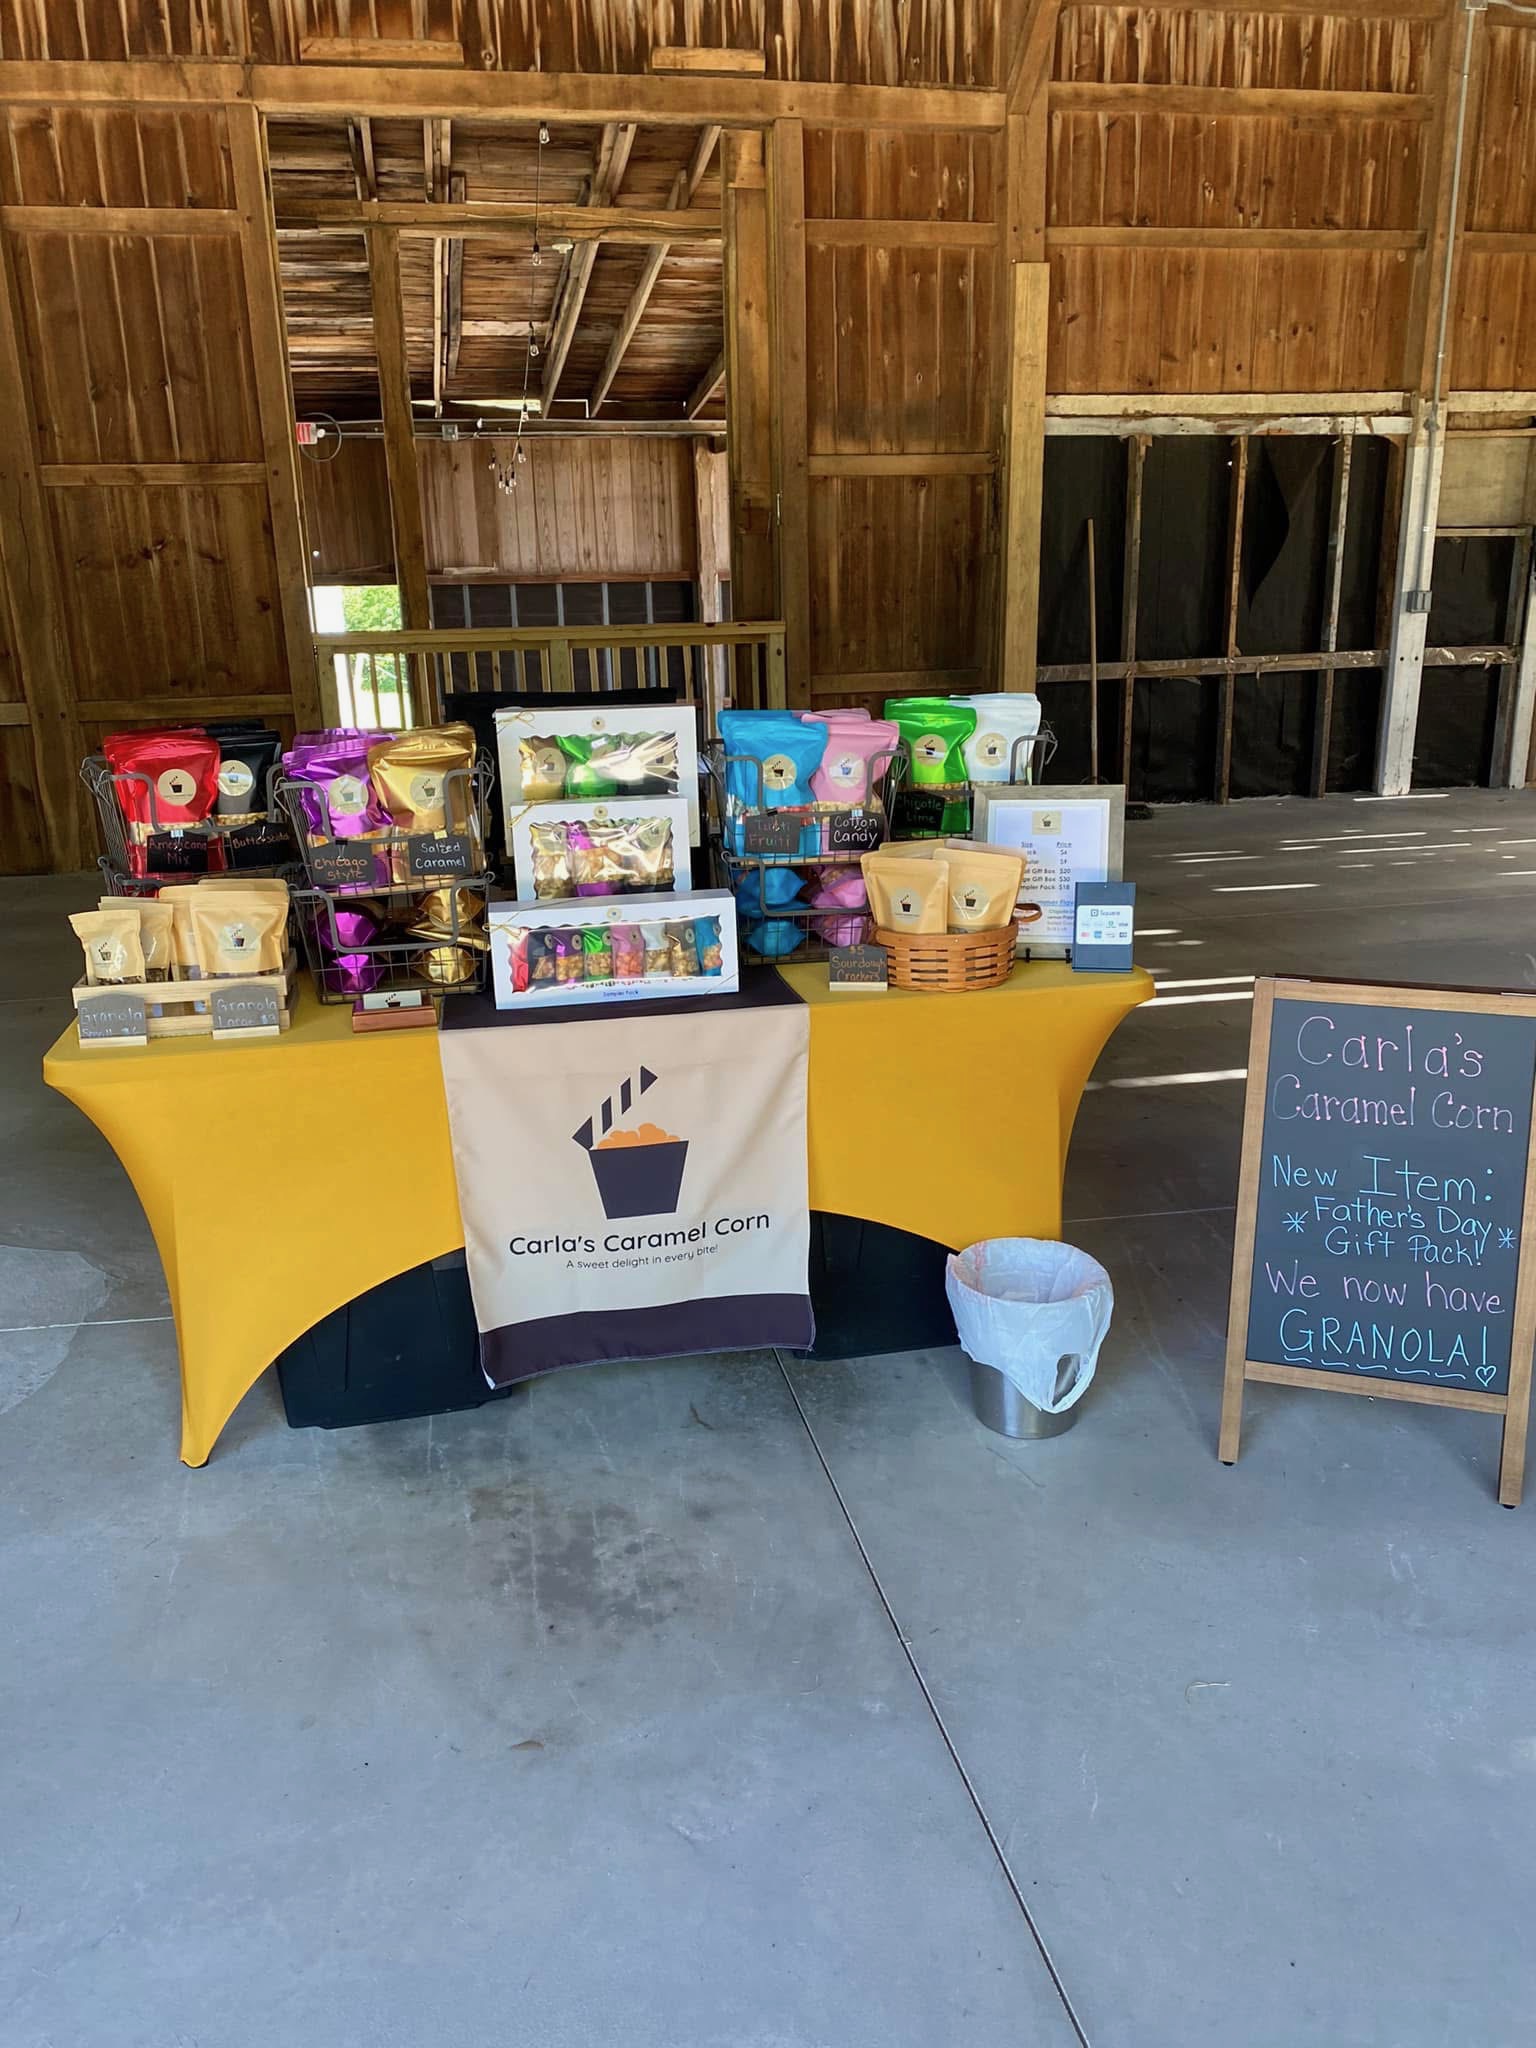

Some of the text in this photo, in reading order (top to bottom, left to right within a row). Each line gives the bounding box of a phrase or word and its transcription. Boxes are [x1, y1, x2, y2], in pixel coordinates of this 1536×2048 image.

[833, 829, 878, 849] Candy
[834, 816, 878, 829] Cotton
[314, 857, 368, 871] Chicago
[415, 855, 466, 869] Caramel
[1297, 1015, 1484, 1078] Carla's
[1272, 1073, 1514, 1133] Caramel Corn
[1273, 1154, 1494, 1204] New Item:
[509, 1214, 770, 1256] Carla's Caramel Corn
[1314, 1195, 1493, 1255] Father's Day
[1324, 1225, 1483, 1267] Gift Pack!
[566, 1243, 719, 1270] A sweet delight in every bite!
[1265, 1259, 1505, 1314] We now have
[1280, 1308, 1489, 1368] GRANOLA!
